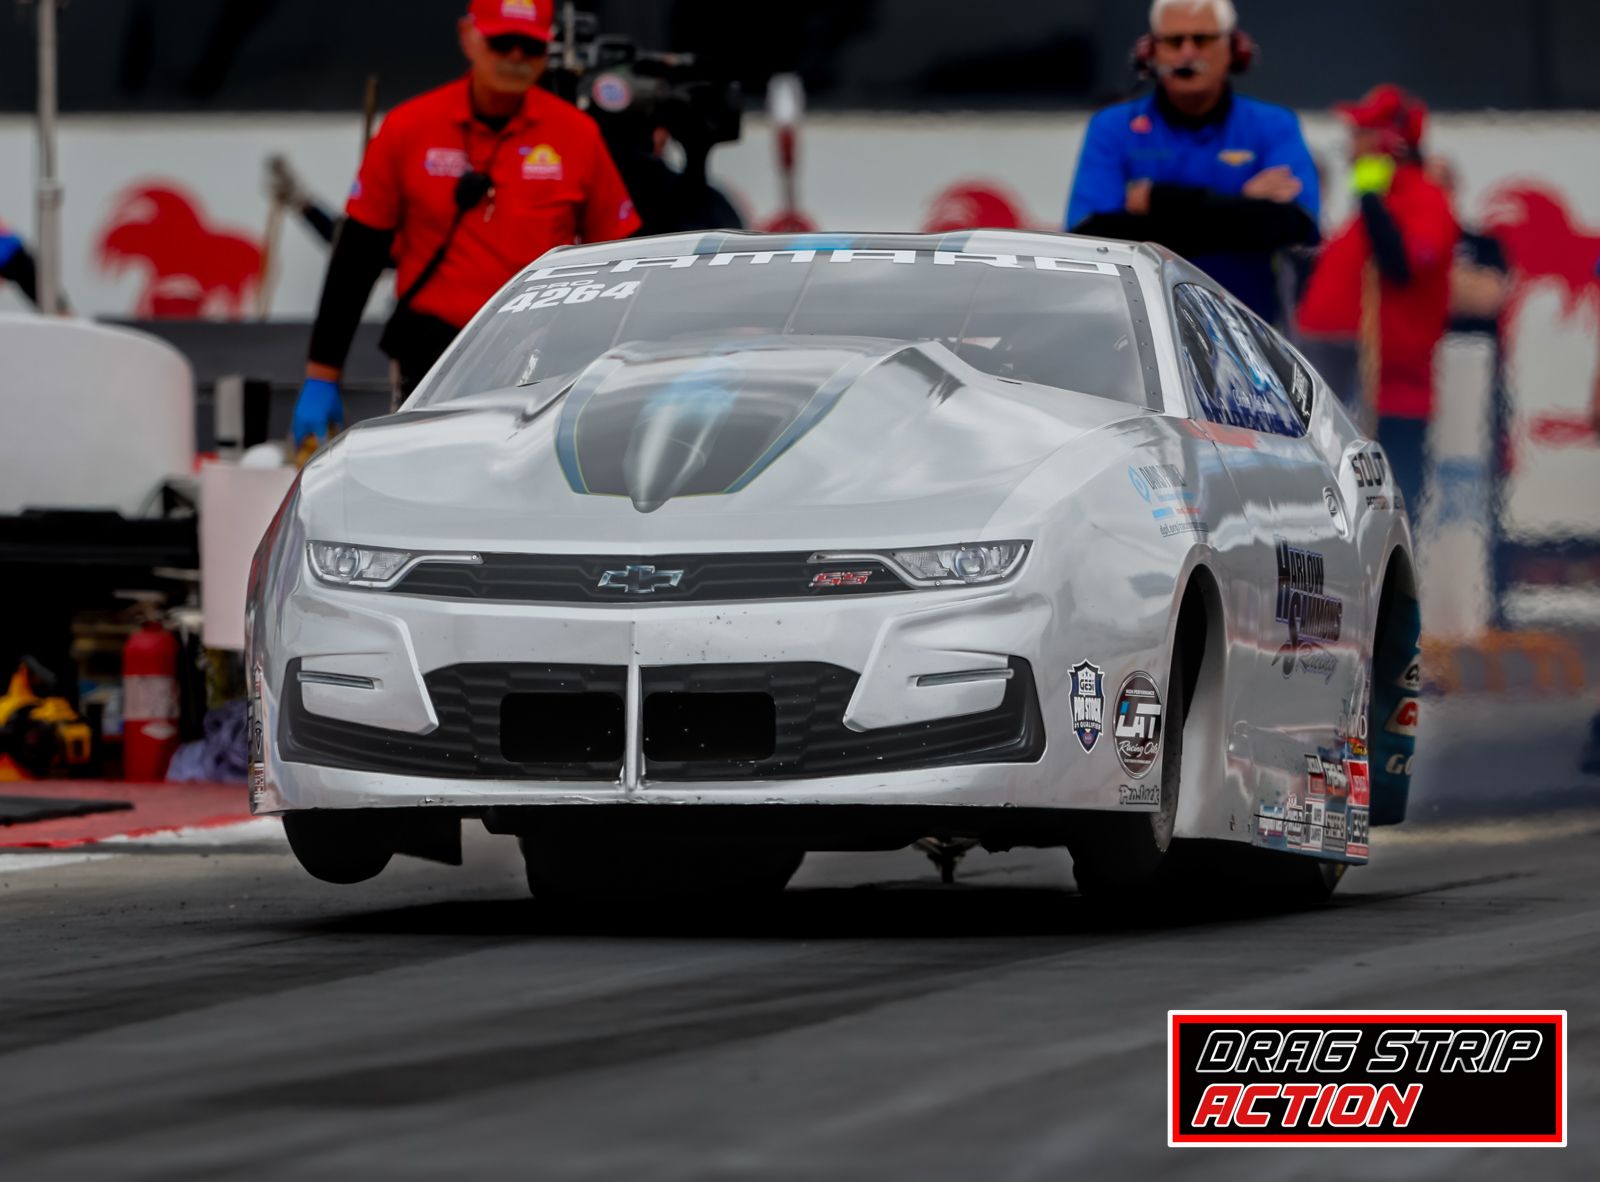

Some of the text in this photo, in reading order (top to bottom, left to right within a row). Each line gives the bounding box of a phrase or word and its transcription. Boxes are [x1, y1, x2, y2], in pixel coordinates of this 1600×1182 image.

[526, 250, 1119, 281] CAMARO
[499, 279, 641, 314] 4264
[809, 571, 872, 587] SS
[1274, 534, 1325, 624] HARLOW
[1115, 700, 1162, 739] LAT
